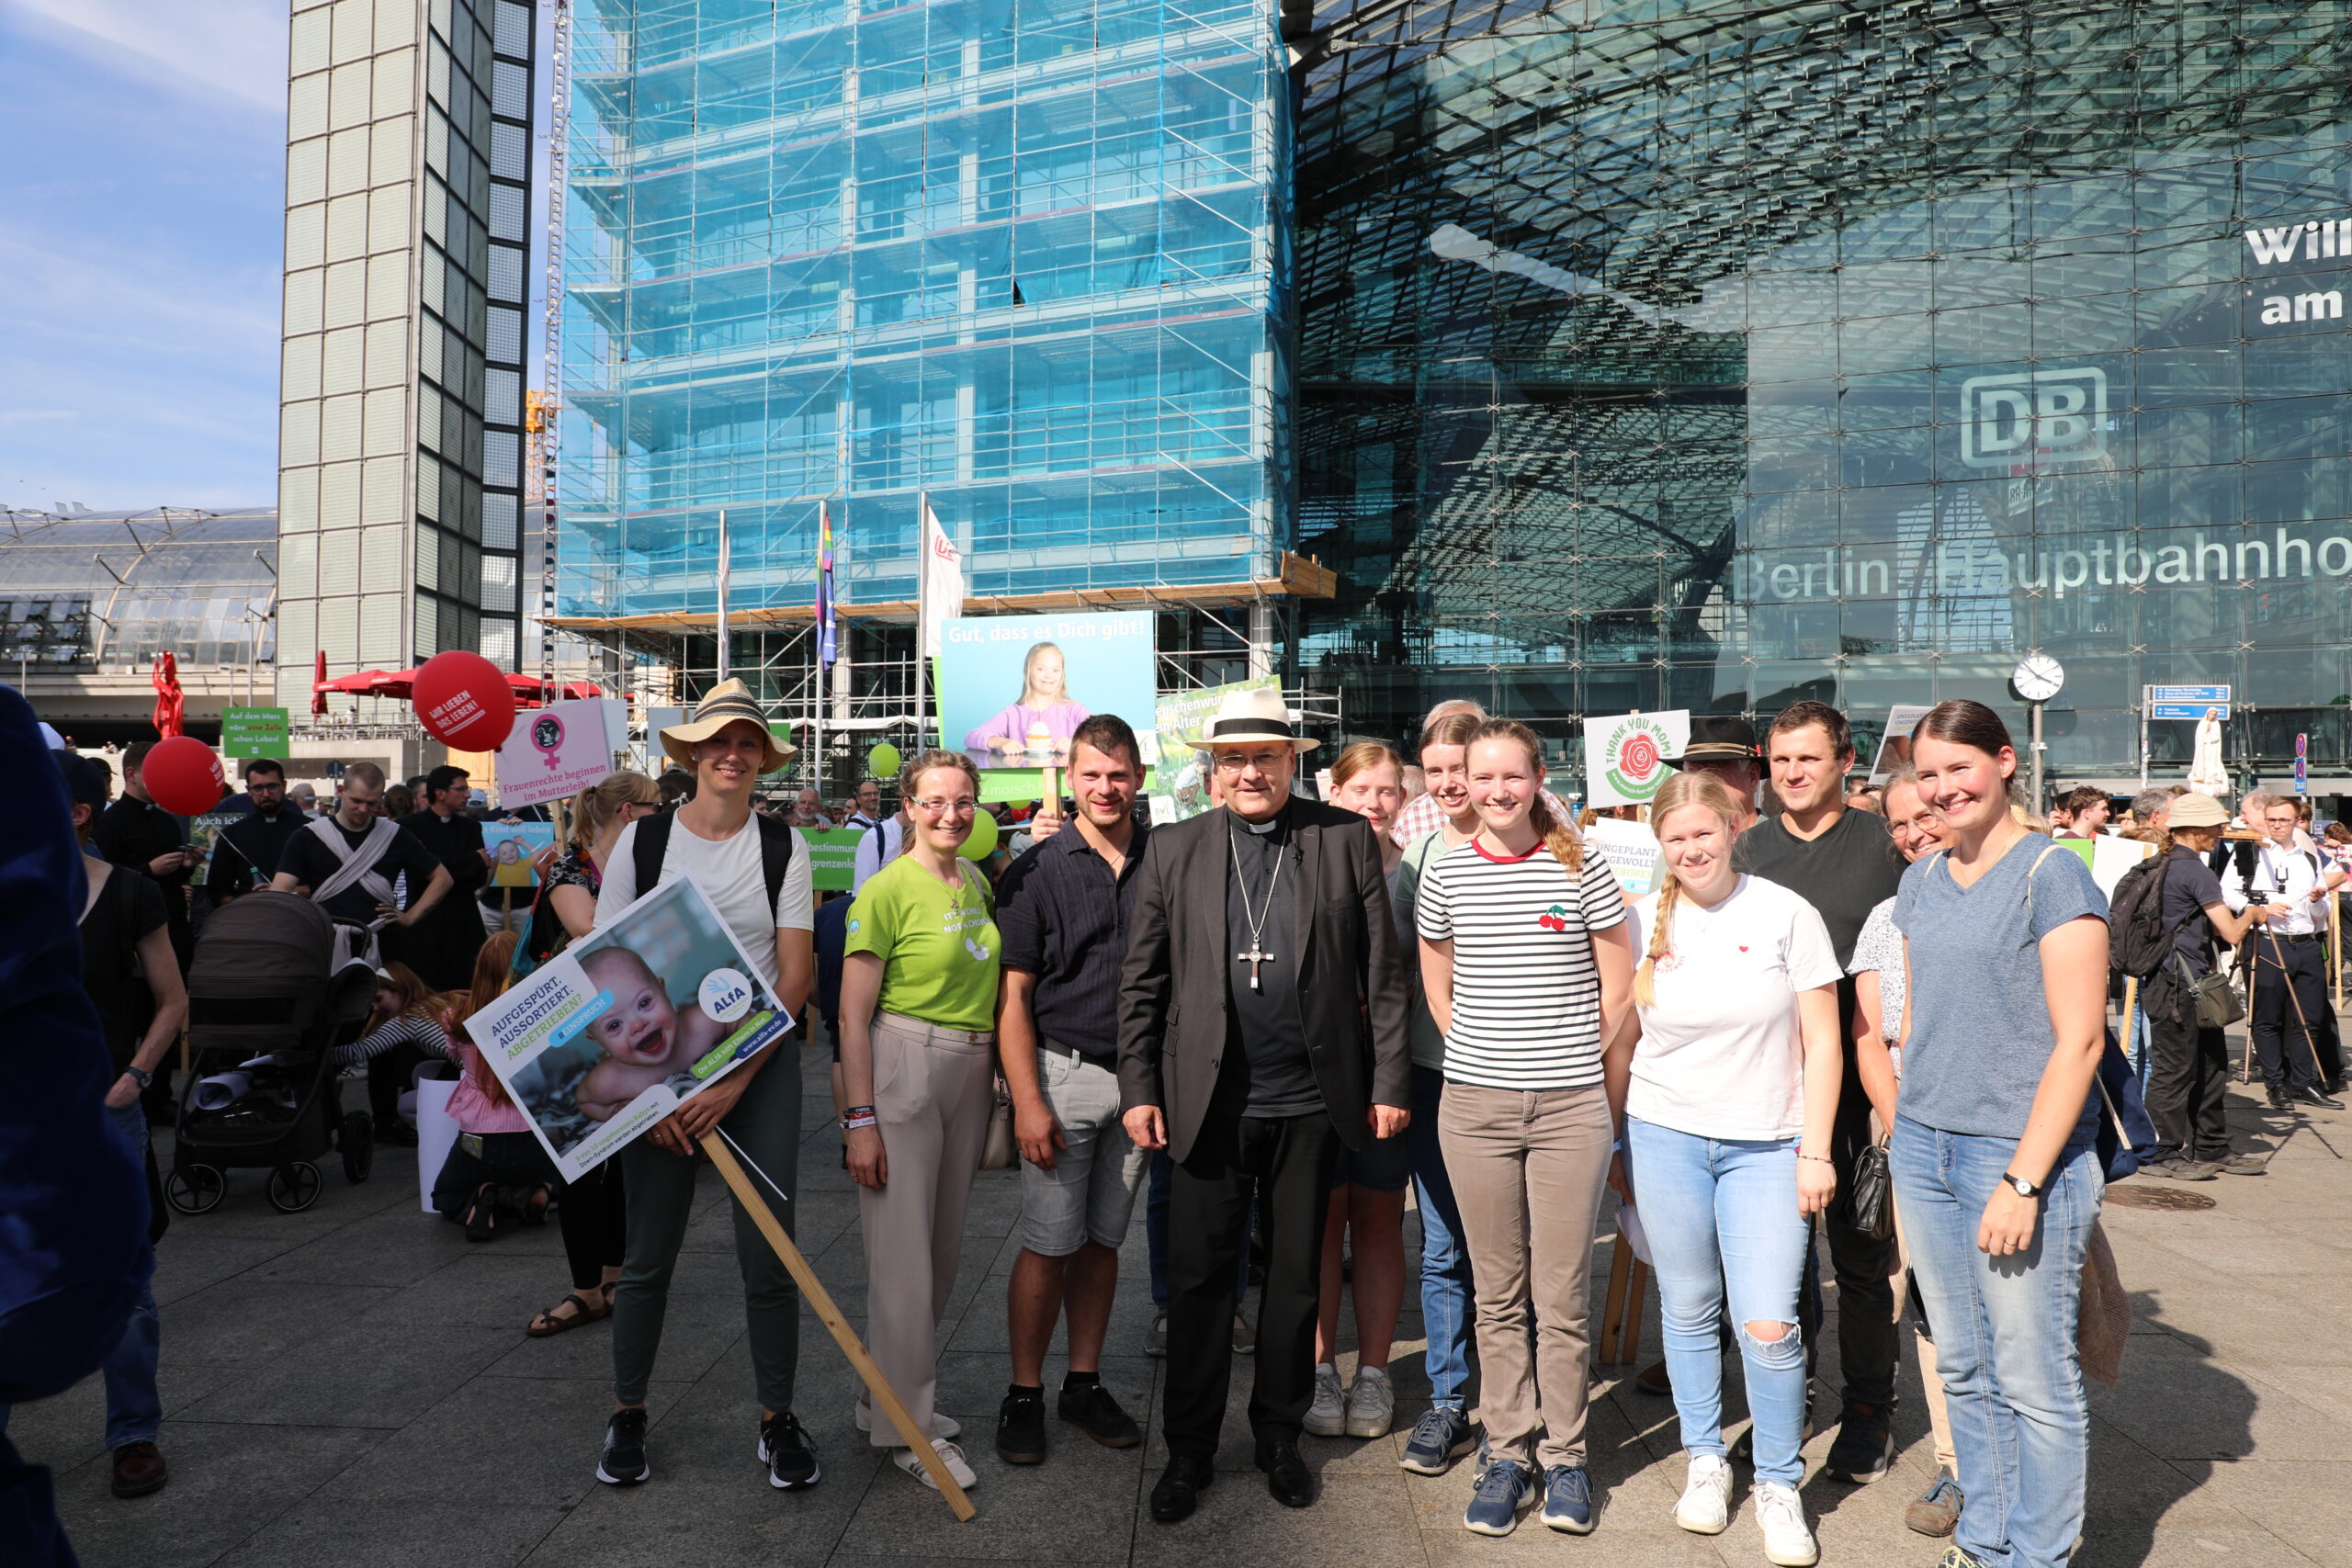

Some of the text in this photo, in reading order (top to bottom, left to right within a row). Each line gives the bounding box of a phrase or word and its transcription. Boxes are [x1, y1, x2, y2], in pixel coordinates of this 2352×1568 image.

[2261, 290, 2342, 325] am
[1734, 527, 2352, 599] Berlin Hauptbahnho
[948, 618, 1145, 643] Gut, dass es Dich gibt!
[428, 690, 471, 719] WIR LIEBEN
[449, 700, 479, 722] LEBEN!
[1173, 715, 1202, 730] Alter
[1606, 717, 1672, 764] THANK YOU MOM!
[503, 764, 606, 794] Frauenrechte beginnen
[524, 780, 589, 801] im Mutterleib!
[195, 817, 221, 825] Auch
[808, 840, 856, 852] bestimmun
[811, 858, 855, 870] grenzenlo
[944, 922, 962, 933] NOT
[968, 917, 992, 927] CHOICE
[491, 976, 562, 1037] AUFGESPÜRT.
[713, 987, 746, 1014] ALfA
[499, 985, 574, 1049] AUSSORTIERT.
[506, 993, 583, 1060] ABGETRIEBEN?
[558, 998, 606, 1040] #EINSPRUCH
[742, 1020, 782, 1053] www.alfa-ev.de
[698, 1064, 708, 1074] Die
[721, 1043, 734, 1055] hilft
[732, 1031, 751, 1046] Eltern
[650, 1101, 660, 1110] mit
[580, 1141, 615, 1168] Down-Syndrom
[614, 1130, 631, 1145] werden
